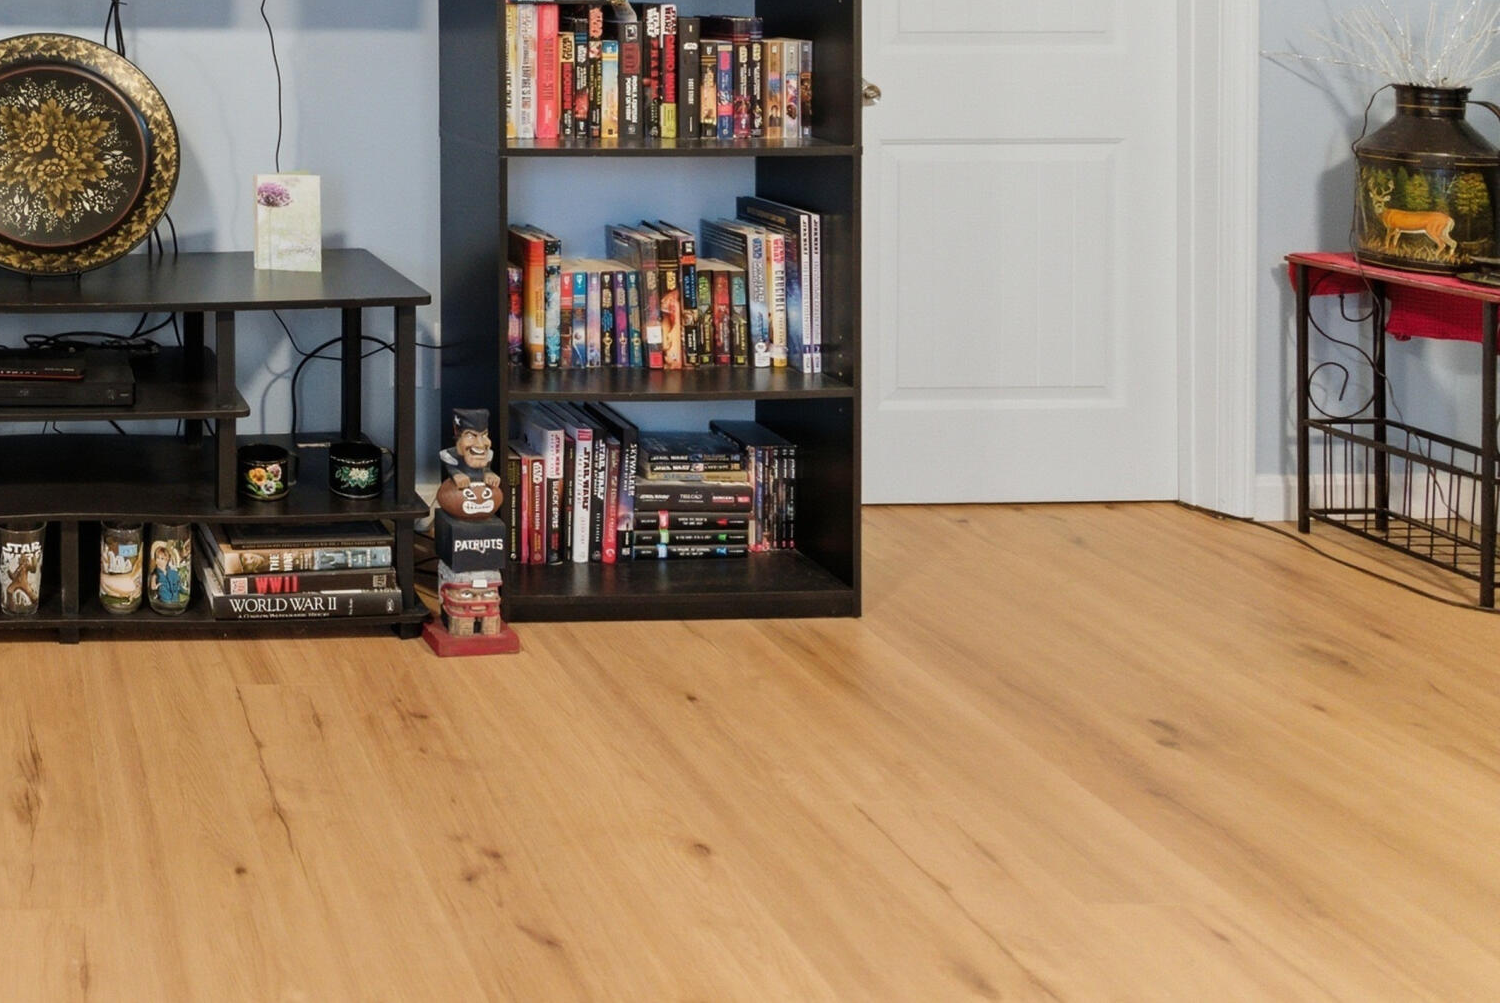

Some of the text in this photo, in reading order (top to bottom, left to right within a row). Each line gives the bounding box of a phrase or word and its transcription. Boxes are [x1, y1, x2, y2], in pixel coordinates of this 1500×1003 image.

[665, 35, 675, 71] CANTO
[650, 39, 658, 99] PHASMA
[775, 269, 784, 313] CRUCIBLE
[582, 447, 590, 511] STAR WARS
[598, 439, 606, 500] STAR WARS
[628, 443, 637, 497] SKYWALKER
[551, 480, 559, 505] BLACK
[1, 541, 42, 554] STAR
[454, 538, 504, 554] PATRIOTS
[269, 553, 280, 572] THE
[283, 552, 294, 572] WAR
[255, 575, 299, 595] WWII
[229, 597, 338, 613] WORLD WAR II
